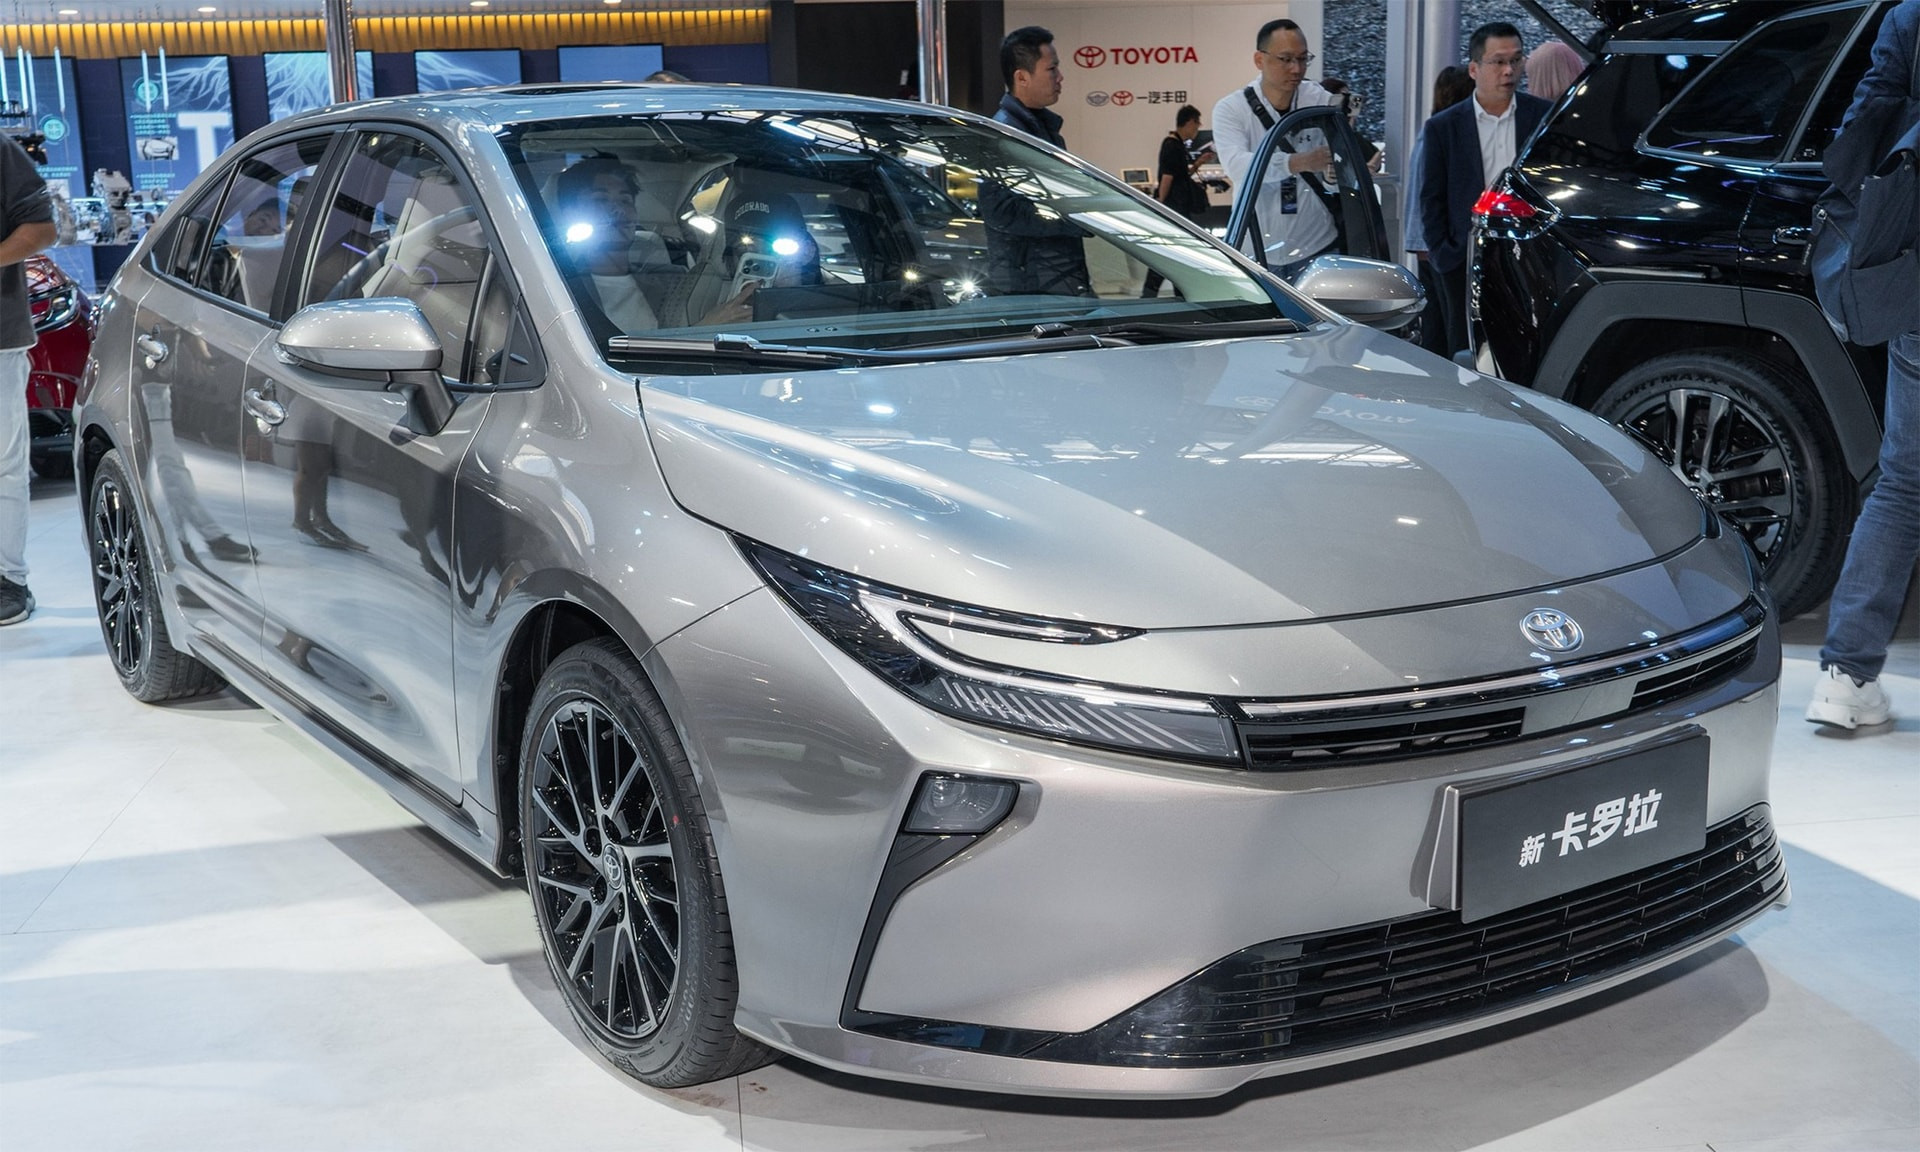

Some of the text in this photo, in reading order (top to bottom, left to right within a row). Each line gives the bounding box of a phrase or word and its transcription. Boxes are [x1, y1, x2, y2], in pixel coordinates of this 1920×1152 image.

[1109, 46, 1198, 65] TOYOTA
[1136, 90, 1187, 104] 一汽丰田
[178, 113, 229, 173] T
[734, 201, 770, 220] COLORADO
[1518, 788, 1663, 868] 新 卡罗拉
